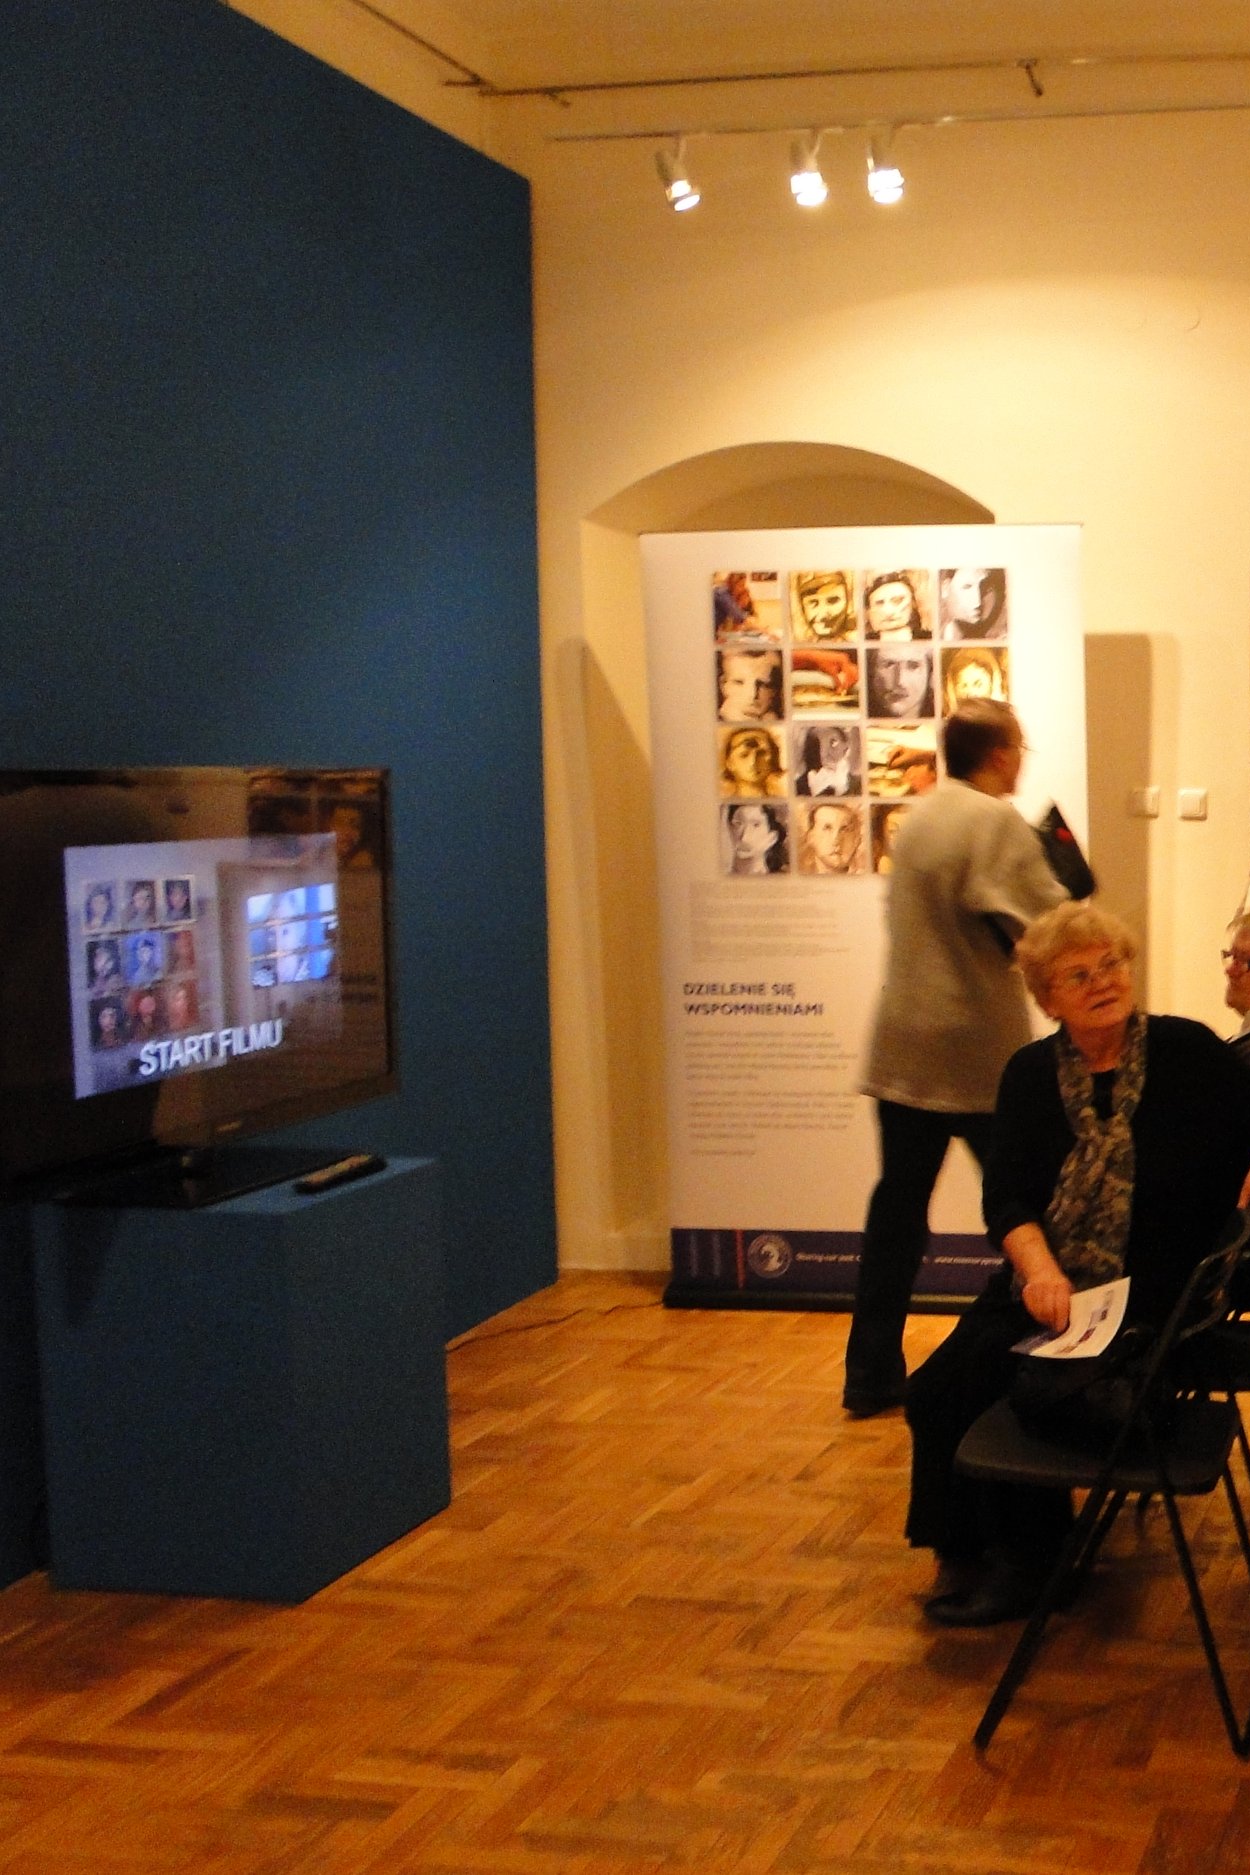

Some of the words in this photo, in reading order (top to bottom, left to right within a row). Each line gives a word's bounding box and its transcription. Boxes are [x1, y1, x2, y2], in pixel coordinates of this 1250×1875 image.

[683, 982, 766, 996] DZIELENIE
[771, 982, 796, 999] SIĘ
[684, 1003, 824, 1016] WSPOMNIENIAMI
[139, 1032, 215, 1076] START
[218, 1018, 283, 1058] FILMU
